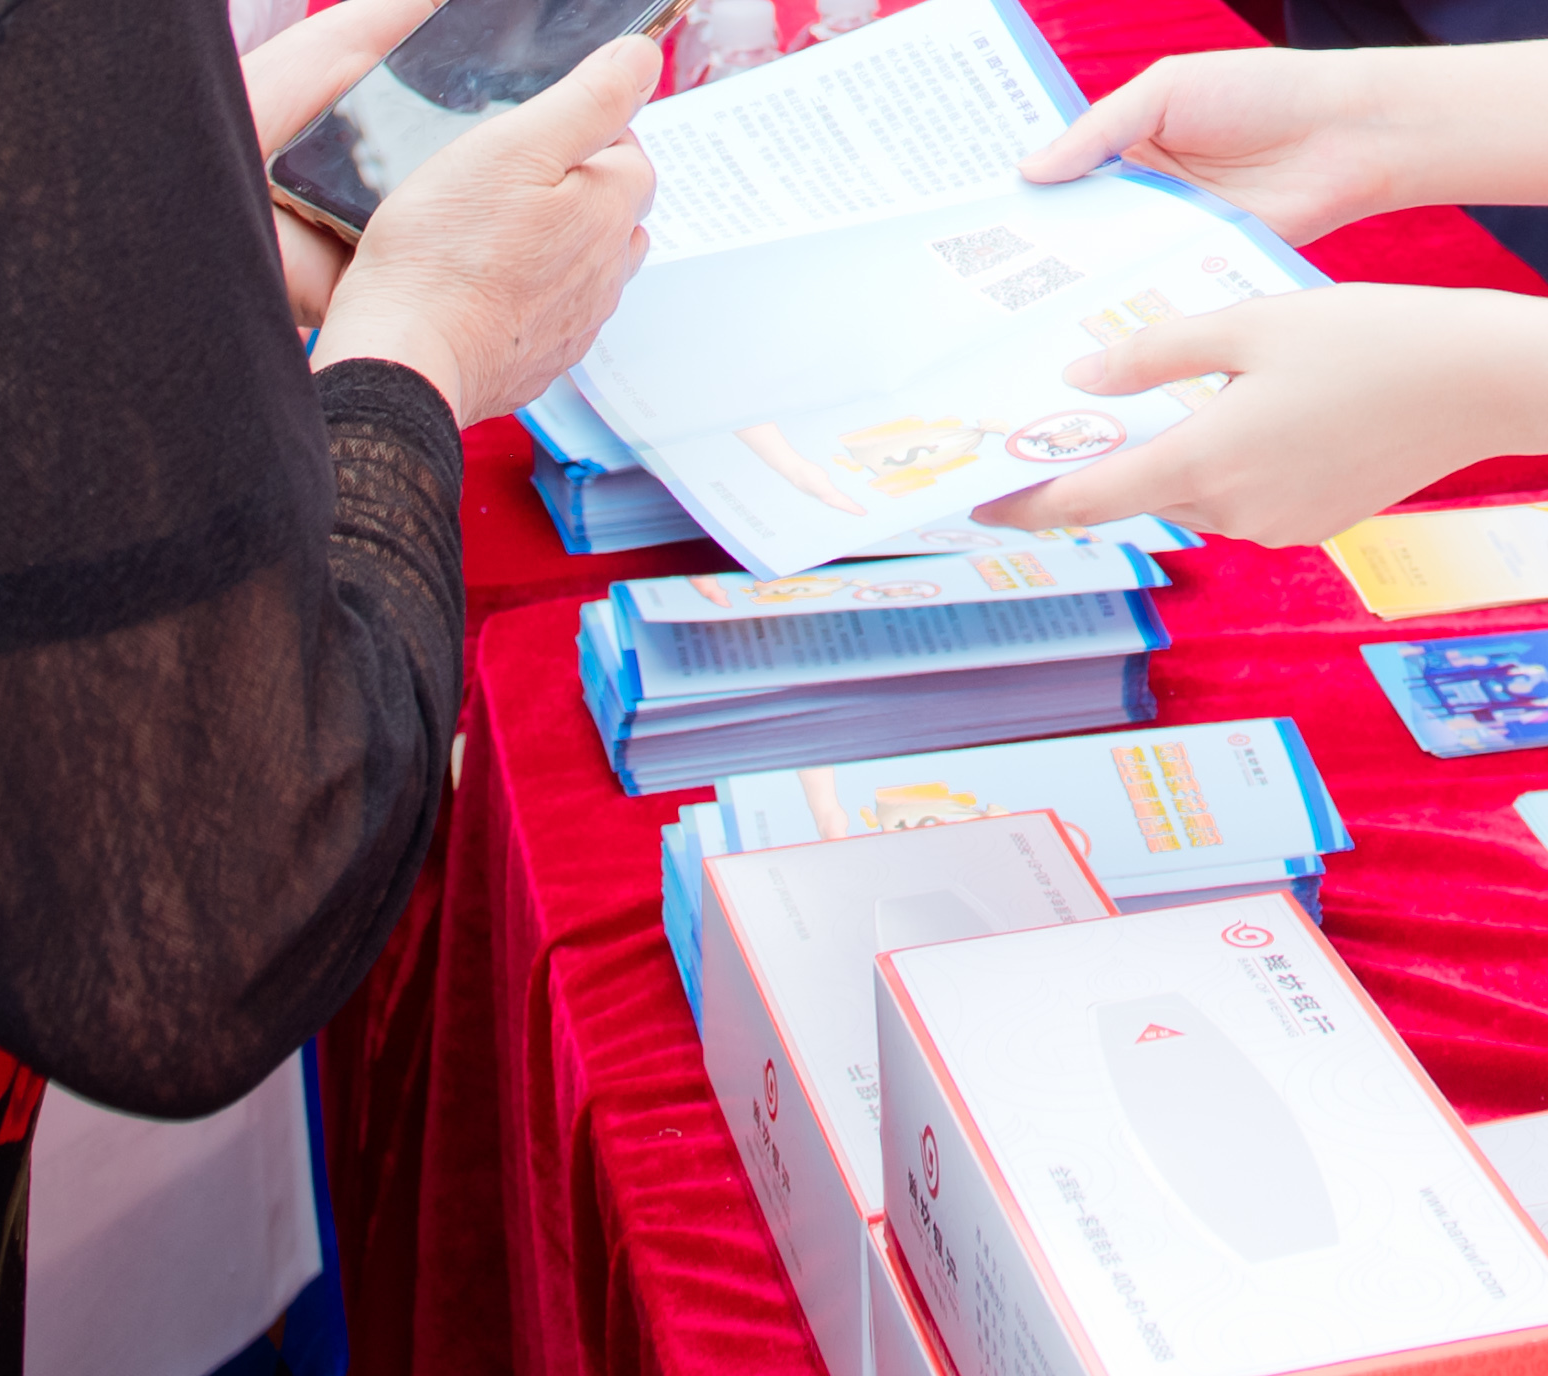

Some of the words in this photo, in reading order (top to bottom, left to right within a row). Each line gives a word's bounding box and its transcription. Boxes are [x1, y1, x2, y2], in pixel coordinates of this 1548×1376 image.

[967, 29, 1043, 125] （四）四个常见手法
[1235, 957, 1261, 981] BANK
[1252, 982, 1271, 995] OF
[1262, 997, 1301, 1038] WEIFANG
[1259, 952, 1339, 1037] 潍坊银行
[907, 1161, 958, 1300] 潍坊银行
[1045, 1164, 1125, 1271] 全国统一客服电话:
[1105, 1269, 1177, 1363] 400-61-96588
[1413, 1185, 1512, 1300] www.bankwf.com
